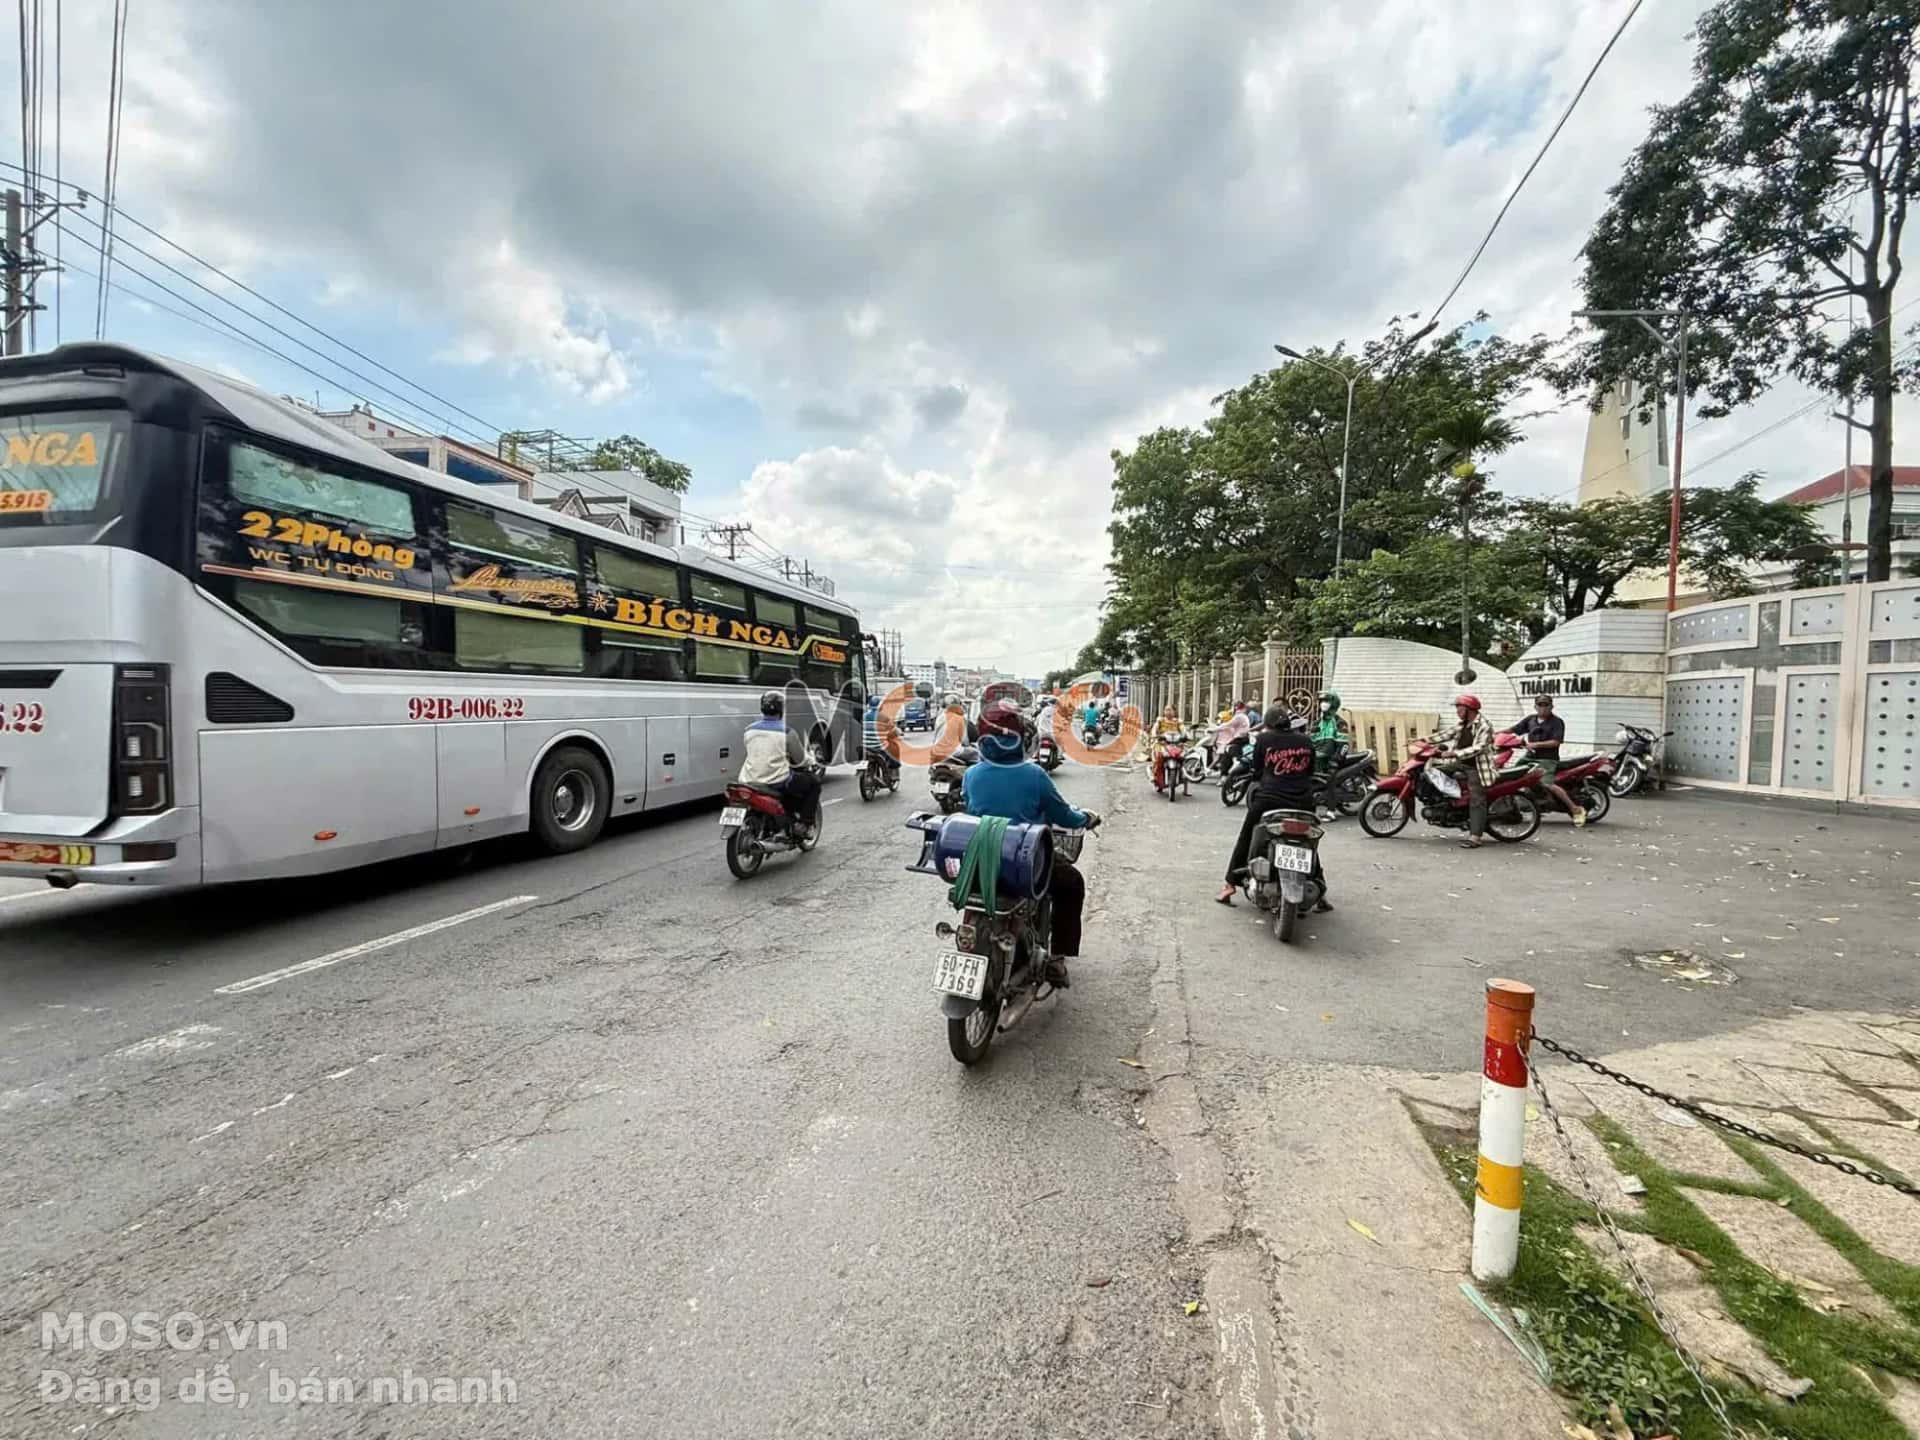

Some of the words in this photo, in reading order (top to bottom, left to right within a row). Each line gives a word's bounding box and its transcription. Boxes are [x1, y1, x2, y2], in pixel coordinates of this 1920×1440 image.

[7, 432, 97, 465] NGA
[238, 511, 416, 569] 22Phòng
[249, 547, 291, 565] WC
[613, 597, 720, 637] BÍCH
[730, 620, 792, 649] NGA
[1563, 673, 1593, 693] TÂM
[408, 697, 524, 720] 92B-006.22
[939, 971, 976, 995] 7369
